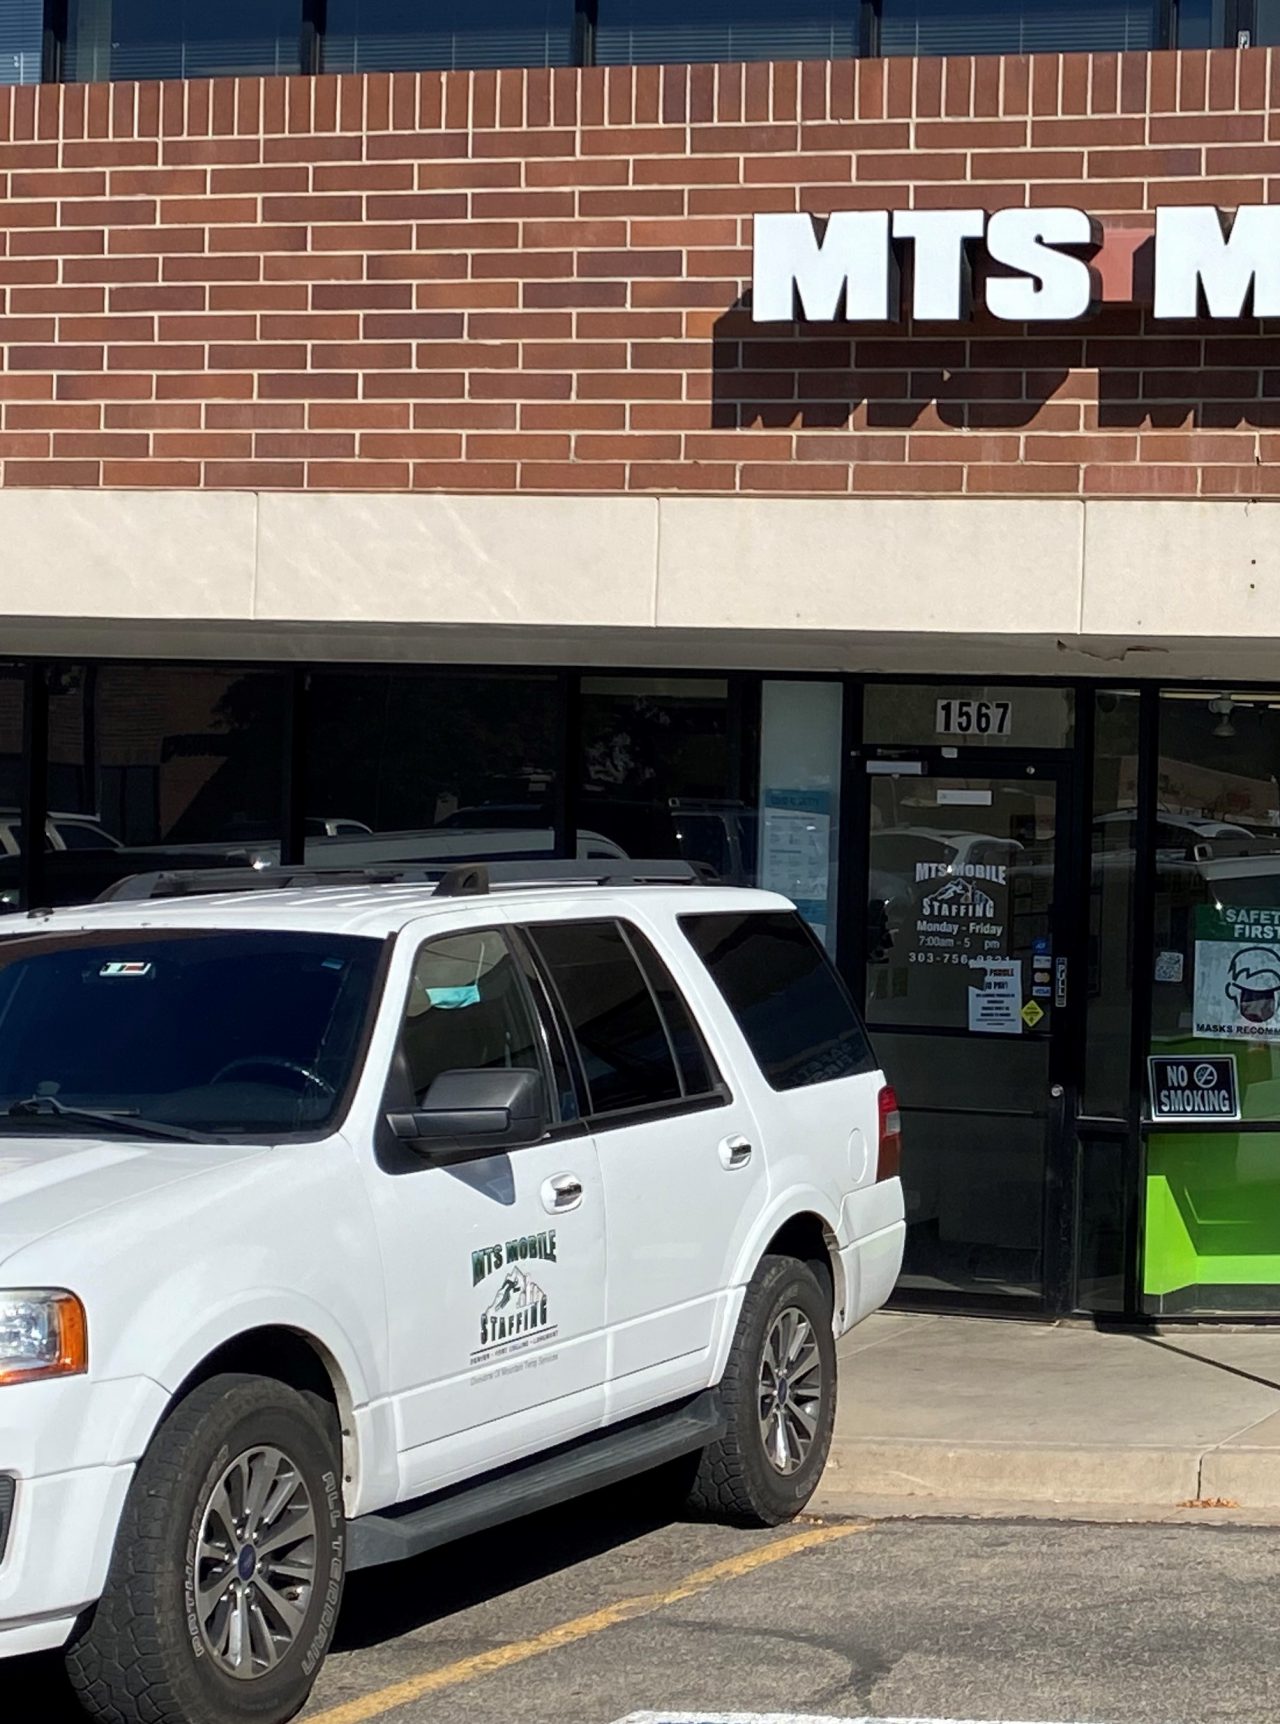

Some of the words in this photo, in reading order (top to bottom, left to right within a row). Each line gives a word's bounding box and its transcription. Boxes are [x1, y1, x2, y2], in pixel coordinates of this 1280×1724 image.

[752, 207, 1096, 322] MTS
[941, 701, 1009, 733] 1567
[916, 863, 947, 882] MTS
[951, 863, 1006, 885] MOBILE
[922, 897, 994, 918] STAFFING
[916, 920, 959, 935] Monday
[969, 922, 1003, 936] Friday
[1196, 1023, 1234, 1033] MASKS
[1167, 1065, 1188, 1087] NO
[1161, 1089, 1230, 1112] SMOKING
[471, 1244, 503, 1287] MTS
[505, 1229, 557, 1265] MOBILE
[480, 1294, 548, 1344] STAFFING
